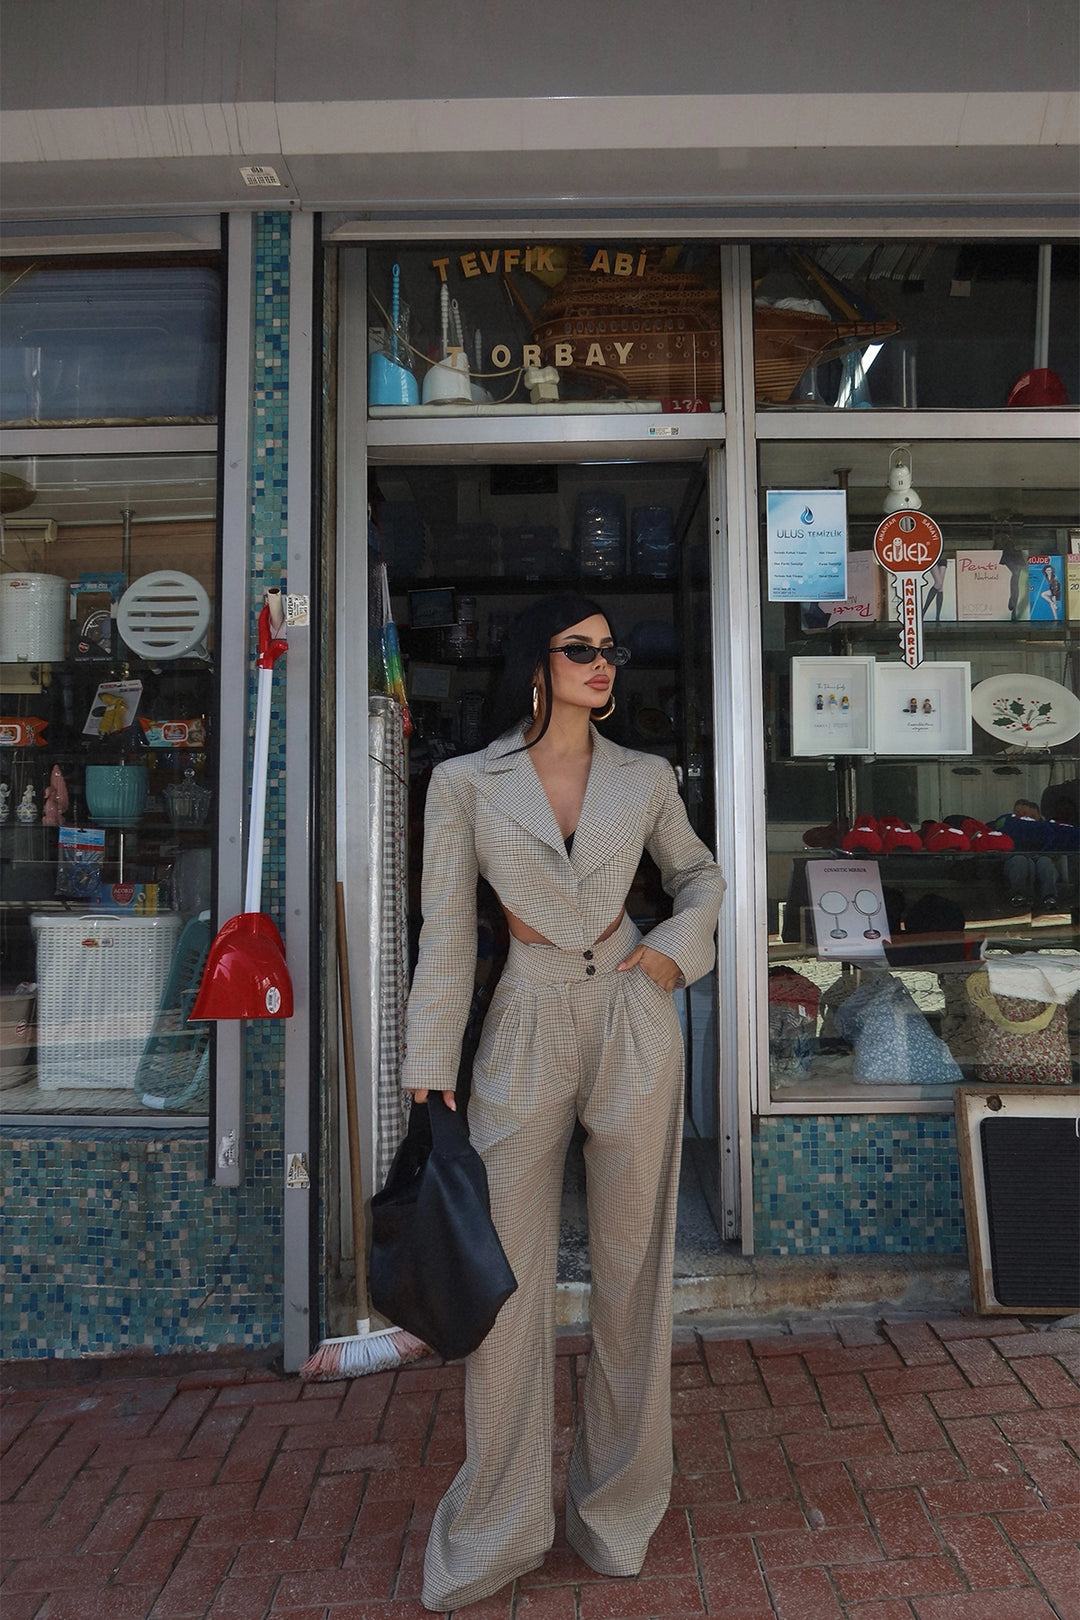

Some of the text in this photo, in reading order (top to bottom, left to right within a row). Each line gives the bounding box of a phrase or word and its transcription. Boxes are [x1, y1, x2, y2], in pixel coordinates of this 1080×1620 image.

[432, 246, 648, 282] TEVFİK ABİ
[776, 529, 843, 539] ULUS TEMİZLİK
[878, 518, 897, 542] ANAHTAR
[959, 558, 998, 572] Penti
[833, 603, 872, 617] Penti
[905, 578, 915, 665] ANAHTARCI
